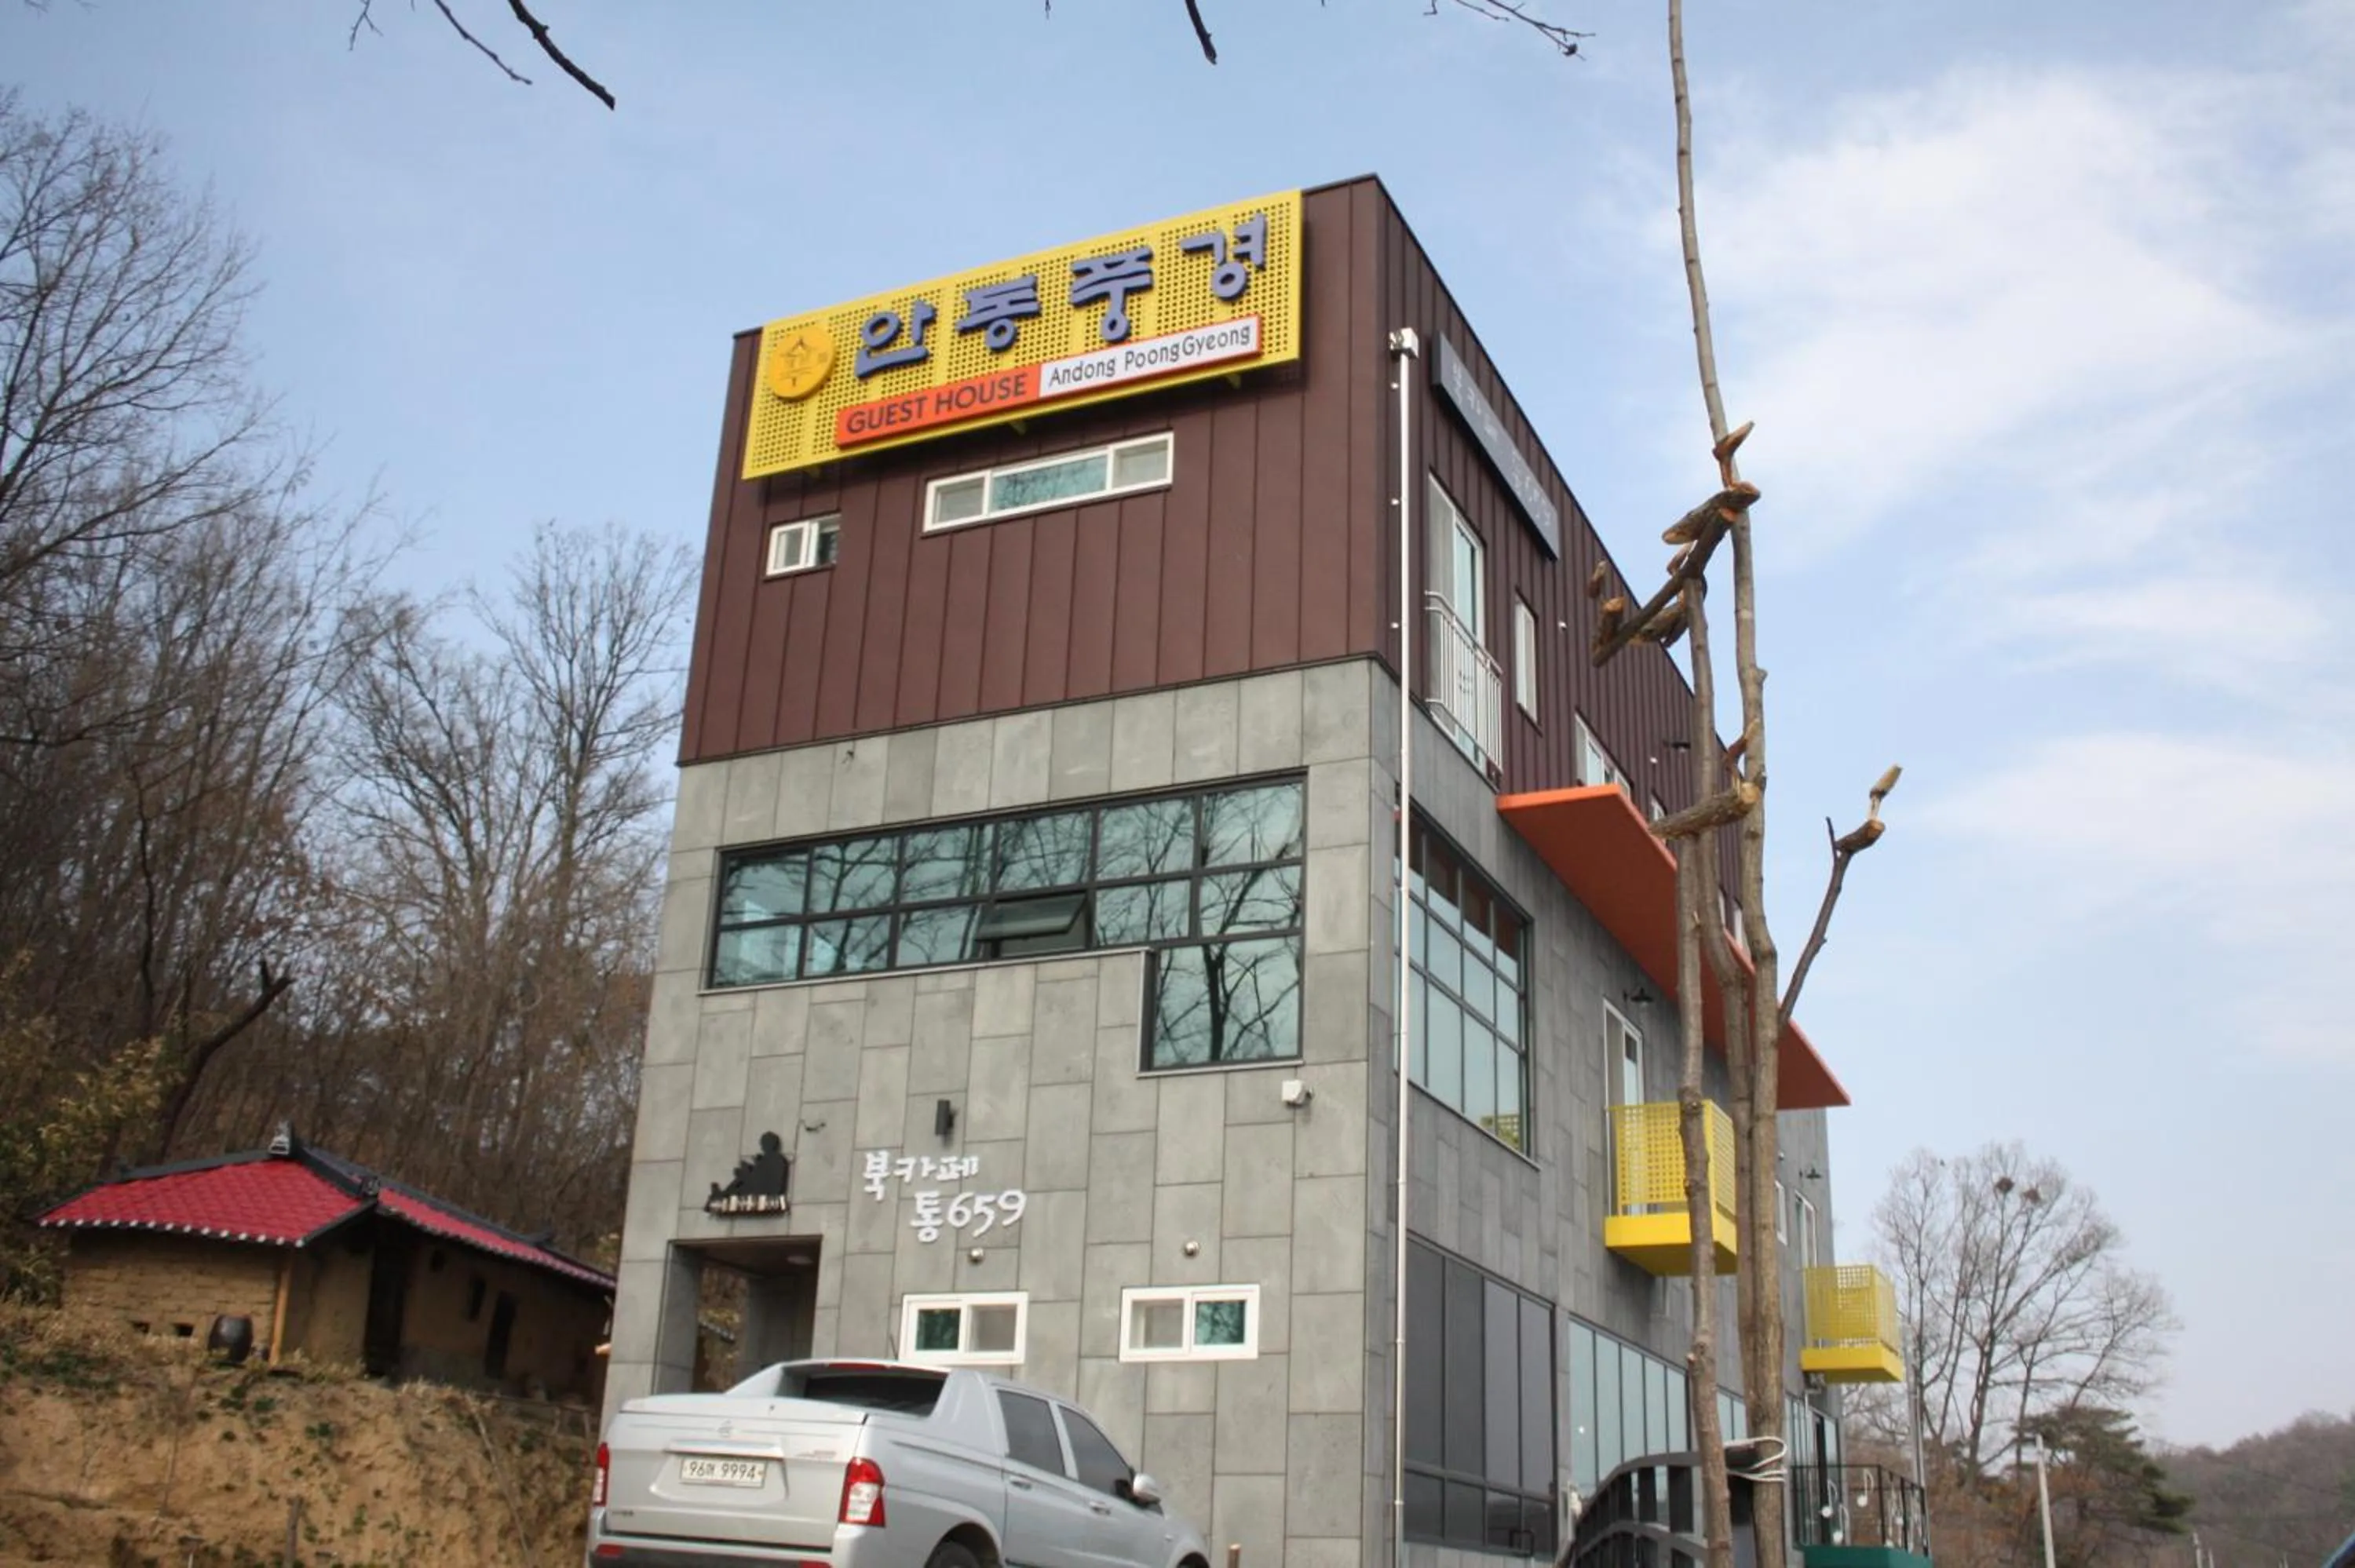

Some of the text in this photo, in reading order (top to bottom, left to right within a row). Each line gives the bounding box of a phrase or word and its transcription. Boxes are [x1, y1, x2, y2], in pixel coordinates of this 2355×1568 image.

[854, 213, 1267, 377] 안동풍경
[1049, 357, 1116, 386] Andong
[847, 374, 1028, 433] GUEST HOUSE
[864, 1150, 980, 1201] 북카페
[910, 1189, 1027, 1242] 통659
[721, 1462, 756, 1479] 9994
